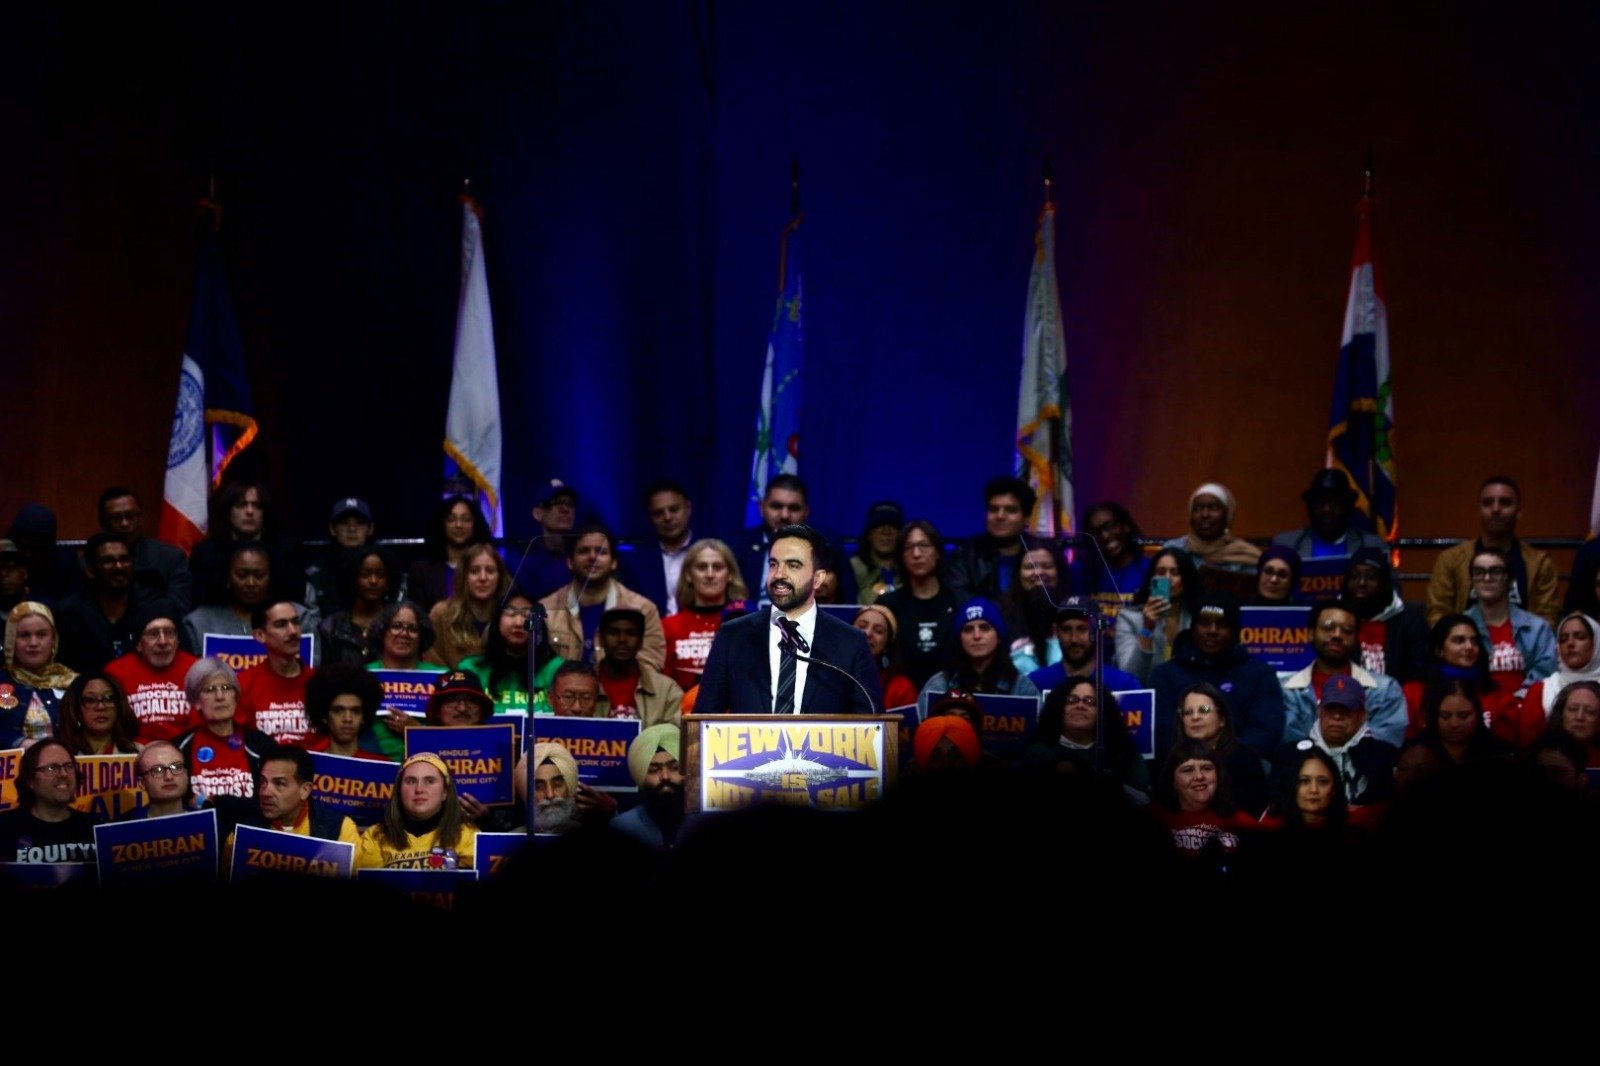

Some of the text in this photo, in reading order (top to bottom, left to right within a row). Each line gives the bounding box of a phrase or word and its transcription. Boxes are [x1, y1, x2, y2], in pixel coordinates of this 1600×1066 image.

[1301, 574, 1344, 592] ZOH
[1239, 627, 1311, 645] OHRAN
[127, 690, 187, 704] EMOCRATI
[980, 714, 1026, 733] RAN
[537, 737, 628, 757] HRAN
[707, 727, 877, 770] NEW YORK
[447, 758, 503, 776] HRAN
[781, 773, 808, 789] IS
[707, 777, 755, 809] NOT
[111, 833, 206, 865] ZOHRAN
[246, 847, 339, 879] ZOHRAN
